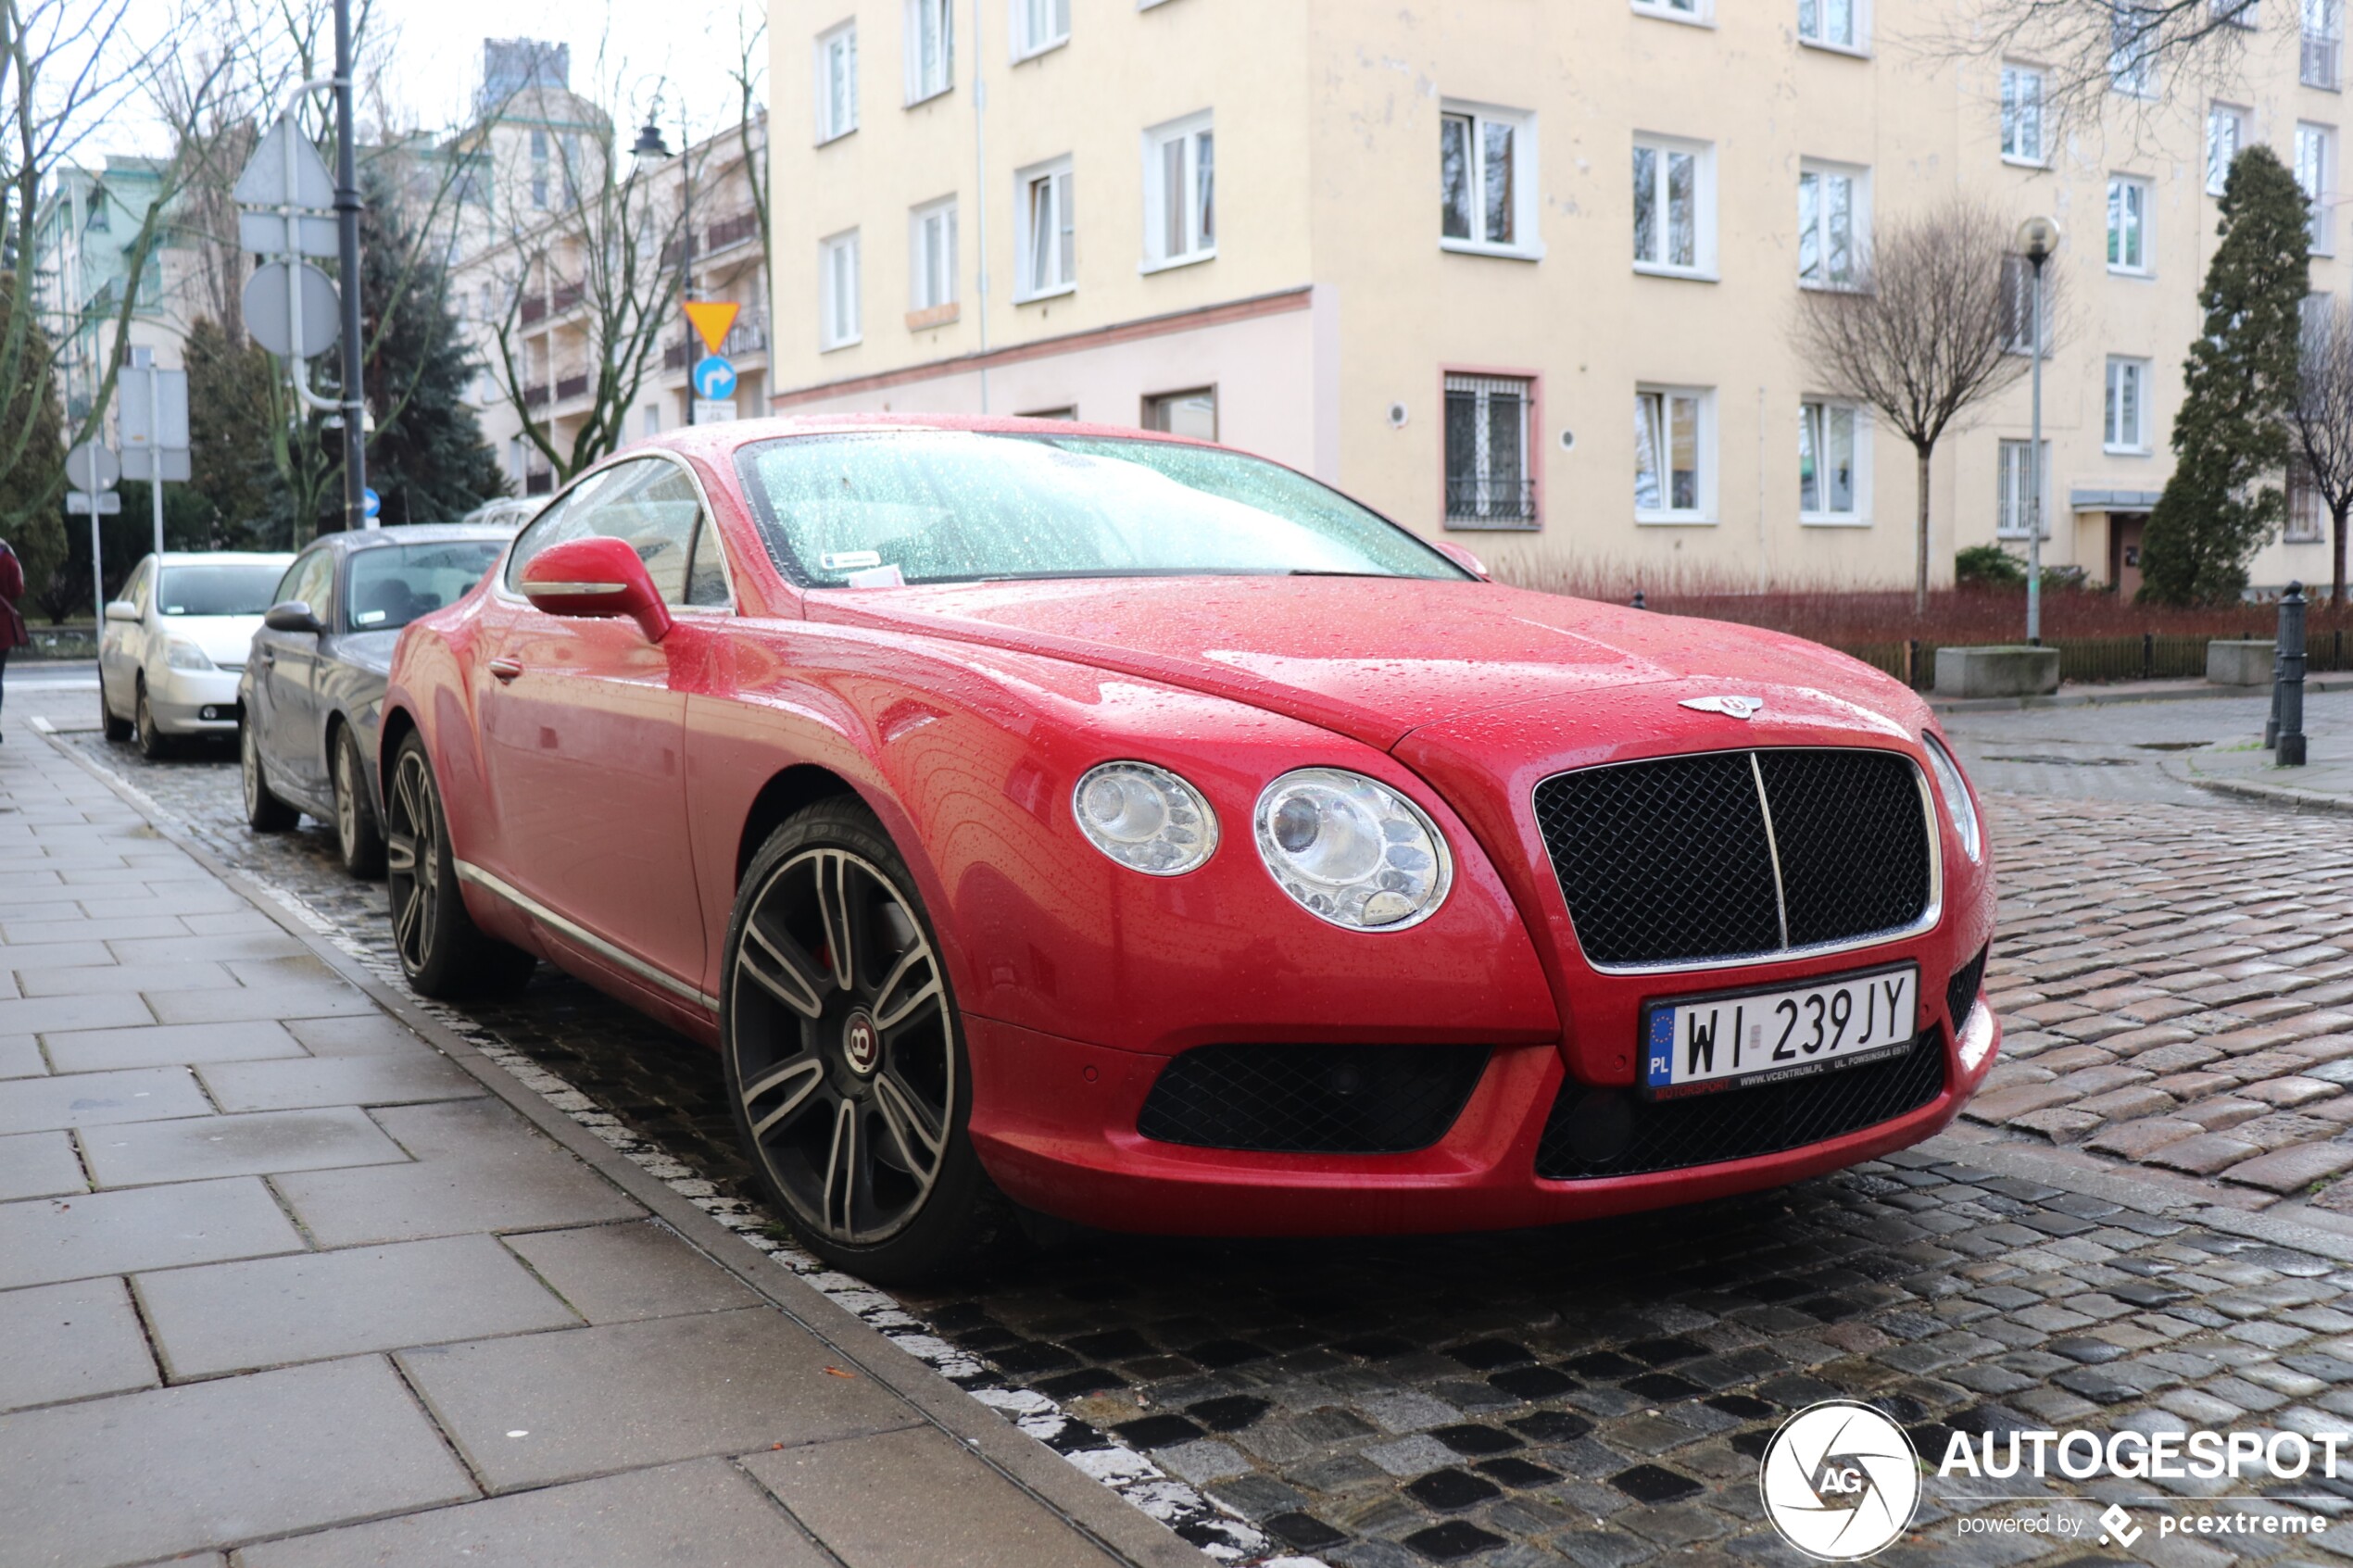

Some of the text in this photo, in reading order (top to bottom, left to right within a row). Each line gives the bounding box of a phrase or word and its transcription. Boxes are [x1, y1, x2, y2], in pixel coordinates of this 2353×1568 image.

[1688, 977, 1906, 1075] WI 239JY
[1649, 1057, 1668, 1074] PL
[1655, 1080, 1730, 1100] MOTORSPORT
[1740, 1063, 1824, 1086] WWW.VCENTRUM.PL
